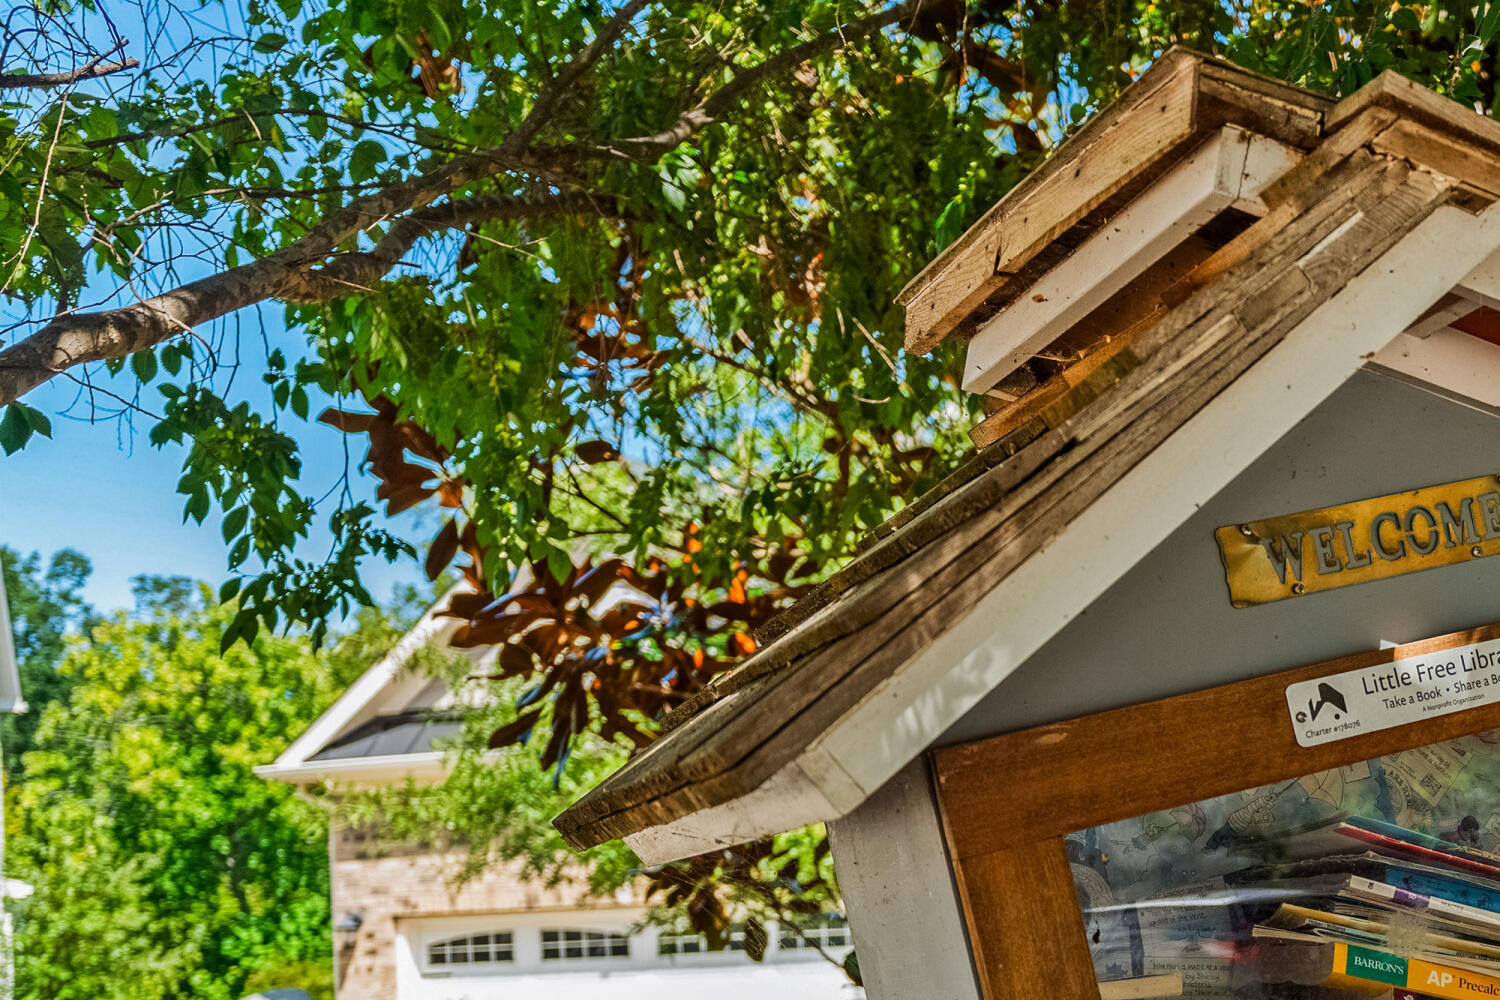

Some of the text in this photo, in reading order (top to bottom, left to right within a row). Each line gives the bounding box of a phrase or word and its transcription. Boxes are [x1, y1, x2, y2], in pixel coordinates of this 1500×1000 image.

[1361, 667, 1413, 695] Little
[1416, 661, 1457, 684] Free
[1382, 694, 1407, 710] Take
[1408, 696, 1415, 705] a
[1417, 688, 1442, 703] Book
[1453, 677, 1483, 694] Share
[1484, 679, 1490, 687] a
[1428, 699, 1453, 713] Nonprofit
[1453, 693, 1485, 707] Organization
[1305, 726, 1332, 739] Charter
[1354, 956, 1404, 975] BARRON'S
[1426, 969, 1453, 988] AP
